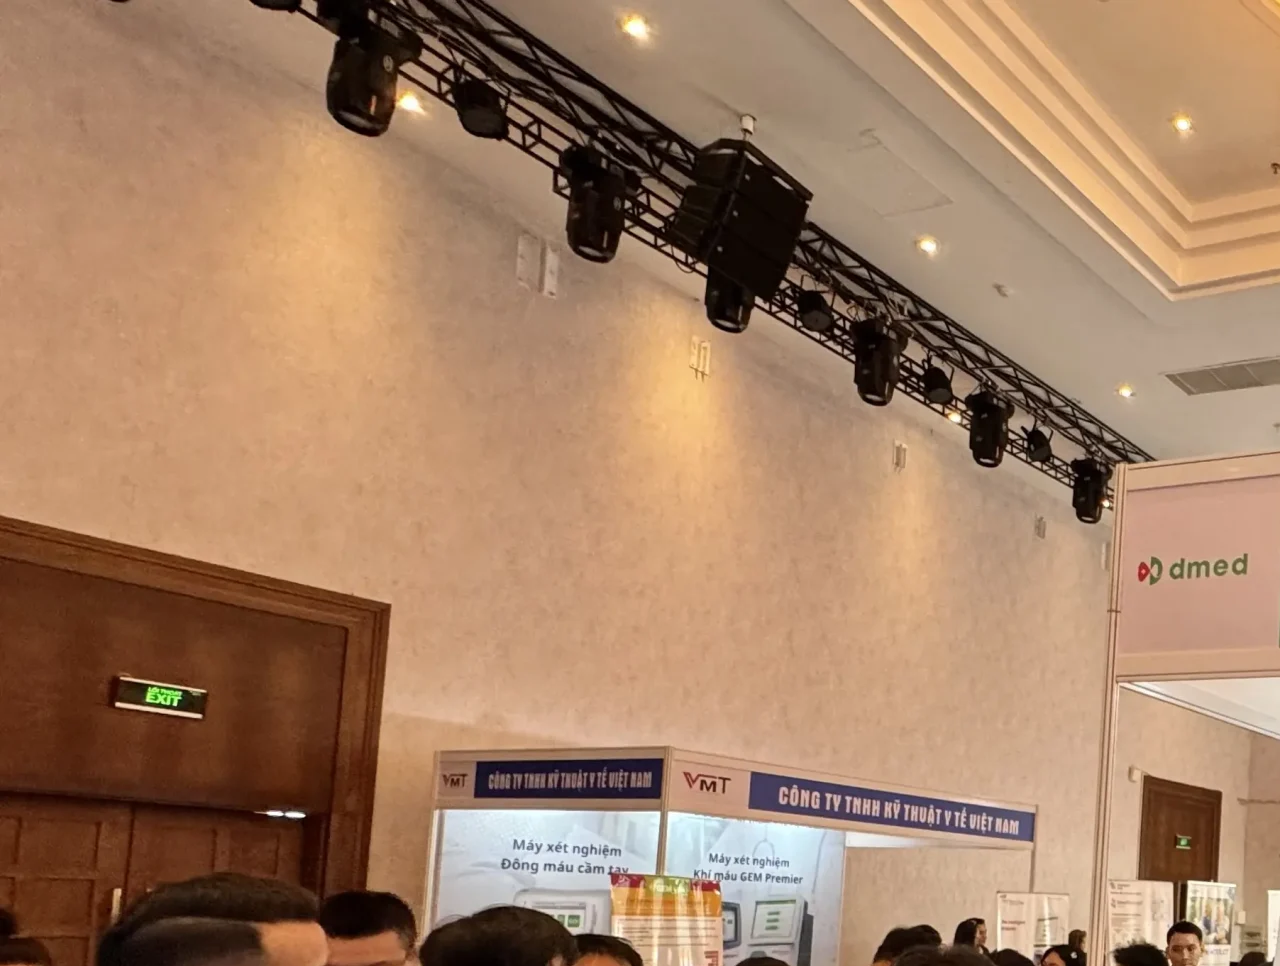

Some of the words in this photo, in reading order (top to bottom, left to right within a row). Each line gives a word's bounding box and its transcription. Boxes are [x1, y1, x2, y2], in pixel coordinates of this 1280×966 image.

[1169, 553, 1250, 581] dmed
[145, 692, 182, 707] EXIT
[442, 773, 468, 789] VMT
[488, 770, 511, 790] CÔNG
[513, 773, 523, 790] TY
[524, 773, 546, 789] TNHH
[630, 771, 653, 788] NAM
[683, 771, 732, 795] VMT
[778, 783, 821, 810] CÔNG
[825, 793, 842, 813] TY
[845, 795, 881, 817] TNHH
[884, 797, 901, 820] KỸ
[903, 803, 942, 828] THUẬT
[944, 808, 953, 824] Y
[954, 806, 967, 829] TẾ
[969, 811, 993, 835] VIỆT
[995, 816, 1021, 836] NAM
[512, 839, 544, 855] Máy
[545, 841, 569, 855] xét
[572, 843, 623, 859] nghiệm
[543, 860, 575, 874] máu
[577, 860, 606, 875] cầm
[708, 853, 732, 868] Máy
[733, 853, 751, 867] xét
[752, 856, 790, 868] nghiệm
[693, 869, 712, 880] Khí
[713, 870, 738, 883] máu
[740, 872, 763, 883] GEM
[765, 873, 804, 885] Premier
